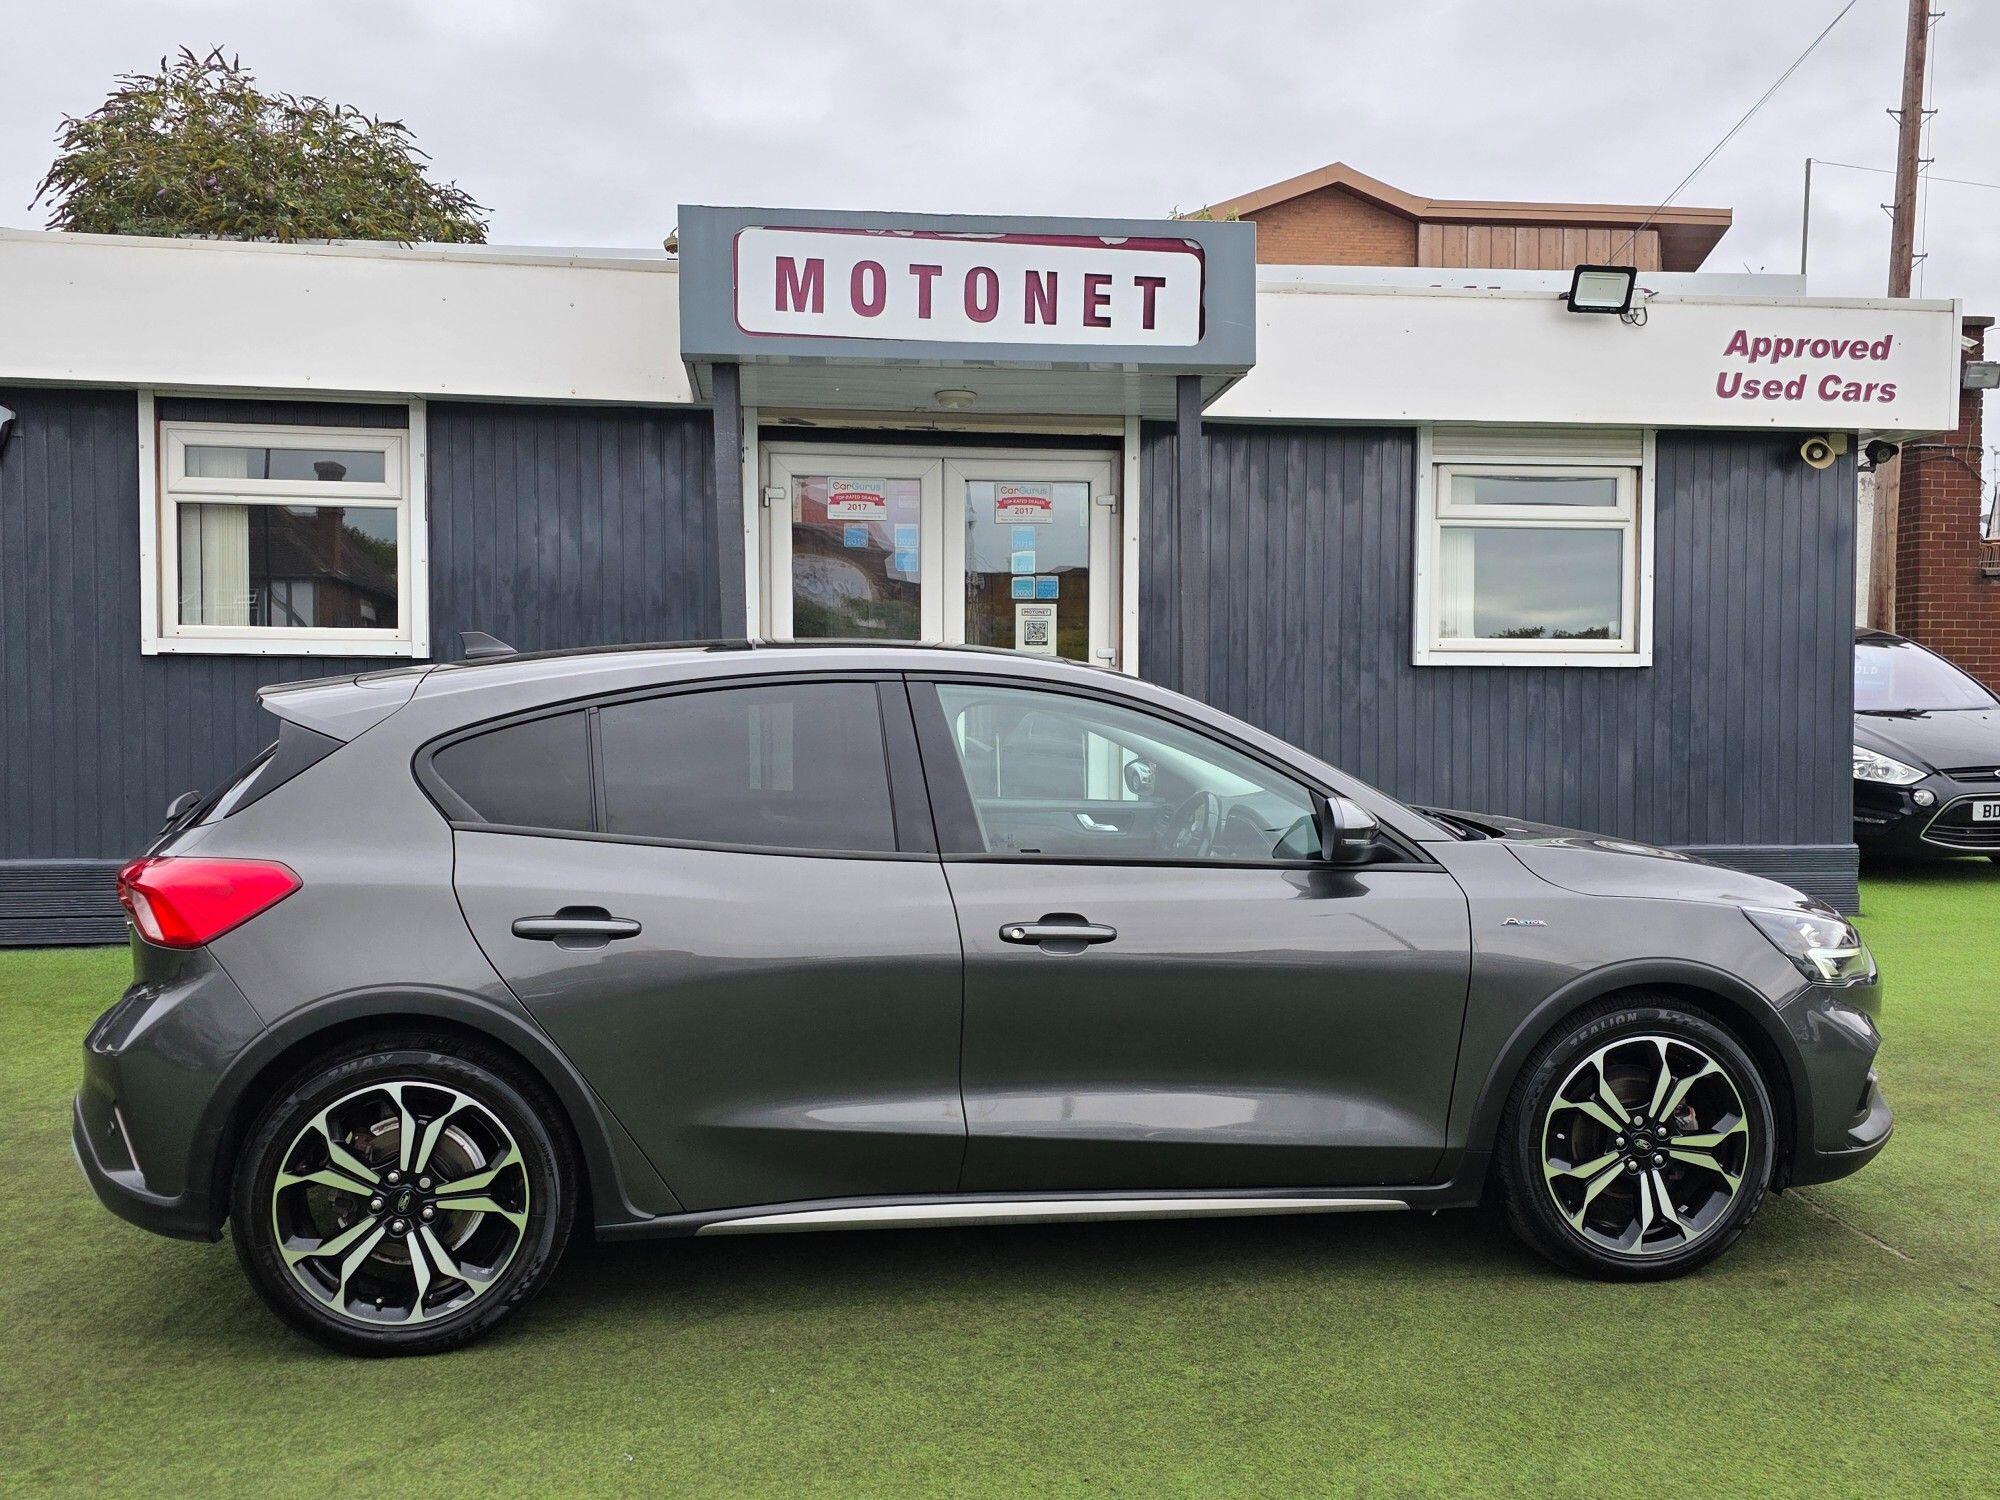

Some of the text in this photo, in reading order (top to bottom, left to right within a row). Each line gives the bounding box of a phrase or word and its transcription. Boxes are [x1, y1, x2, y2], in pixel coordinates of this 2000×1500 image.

[775, 256, 1167, 330] MOTONET
[1723, 329, 1893, 364] Approved
[1716, 372, 1897, 403] Used Cars
[832, 481, 881, 491] CarGurus
[1000, 486, 1048, 495] CarGurus
[1014, 507, 1034, 515] 2017
[1855, 666, 1878, 674] OLD
